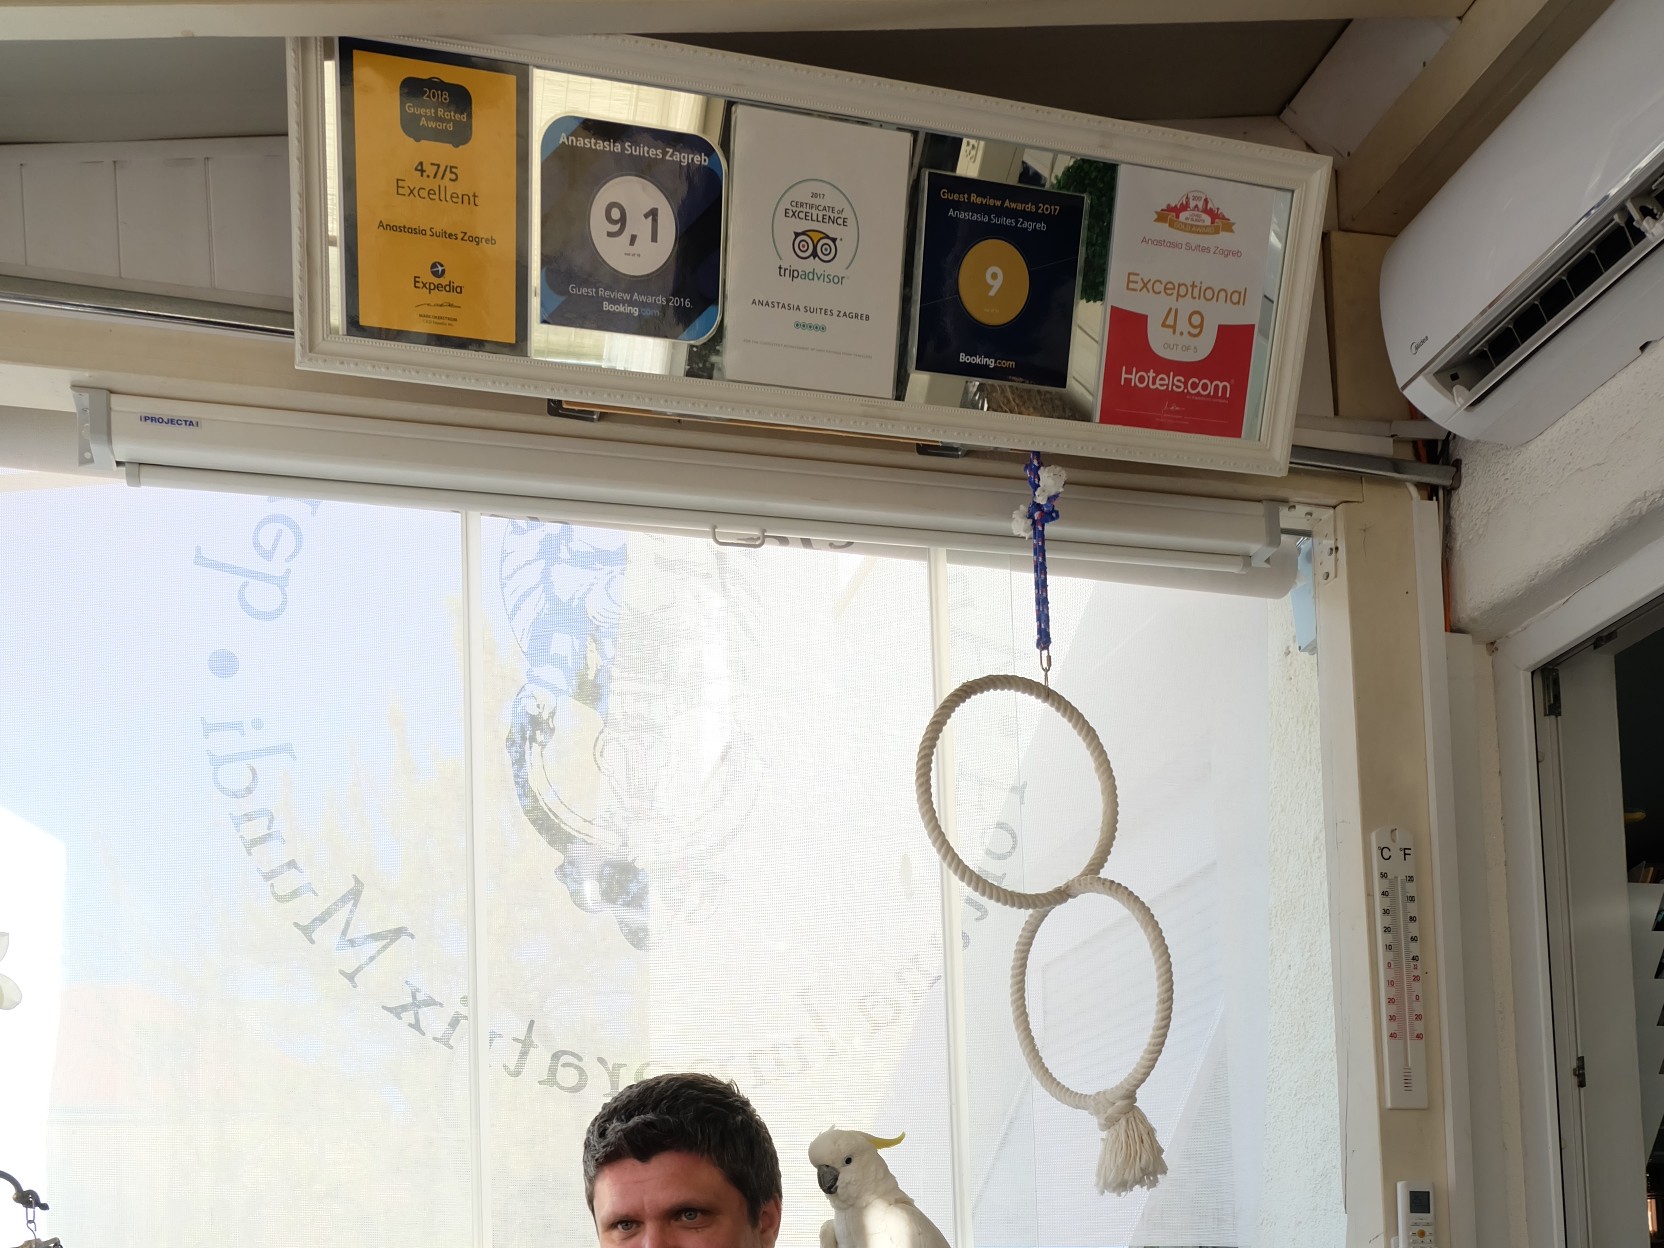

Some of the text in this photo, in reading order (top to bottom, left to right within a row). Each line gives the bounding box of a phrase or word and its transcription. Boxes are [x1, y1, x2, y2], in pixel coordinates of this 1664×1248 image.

[423, 88, 450, 103] 2018
[405, 103, 467, 122] Guest Rated
[420, 117, 453, 131] Award
[559, 132, 709, 166] Anastasia Suites Zagreb
[414, 161, 459, 182] 4.7/5
[396, 178, 479, 207] Excellent
[810, 191, 826, 200] 2017
[940, 189, 1060, 216] Guest Review Awards 2017
[784, 208, 848, 227] EXCELLENCE
[790, 200, 844, 216] CERTIFICATE of
[604, 201, 660, 246] 9,1
[948, 208, 1047, 232] Anastasia Suites Zagreb
[377, 219, 497, 246] Anastasia Suites Zagreb
[1141, 236, 1243, 258] Anastasia Suites Zagreb
[413, 275, 463, 295] Expedia
[778, 264, 845, 286] tripadvisor
[985, 266, 1004, 297] 9
[569, 284, 596, 297] Guest
[598, 287, 631, 301] Review
[633, 292, 666, 305] Awards
[1126, 272, 1247, 306] Exceptional
[603, 301, 660, 316] Booking.com
[751, 298, 870, 322] ANASTASIA SUITES ZAGREB
[1161, 307, 1205, 338] 4.9
[1163, 342, 1179, 351] OUT
[1181, 344, 1191, 352] OF
[959, 352, 1016, 368] Booking.com
[1121, 366, 1231, 398] Hotels.com
[144, 415, 195, 427] PROJECTA
[1380, 871, 1388, 879] 50
